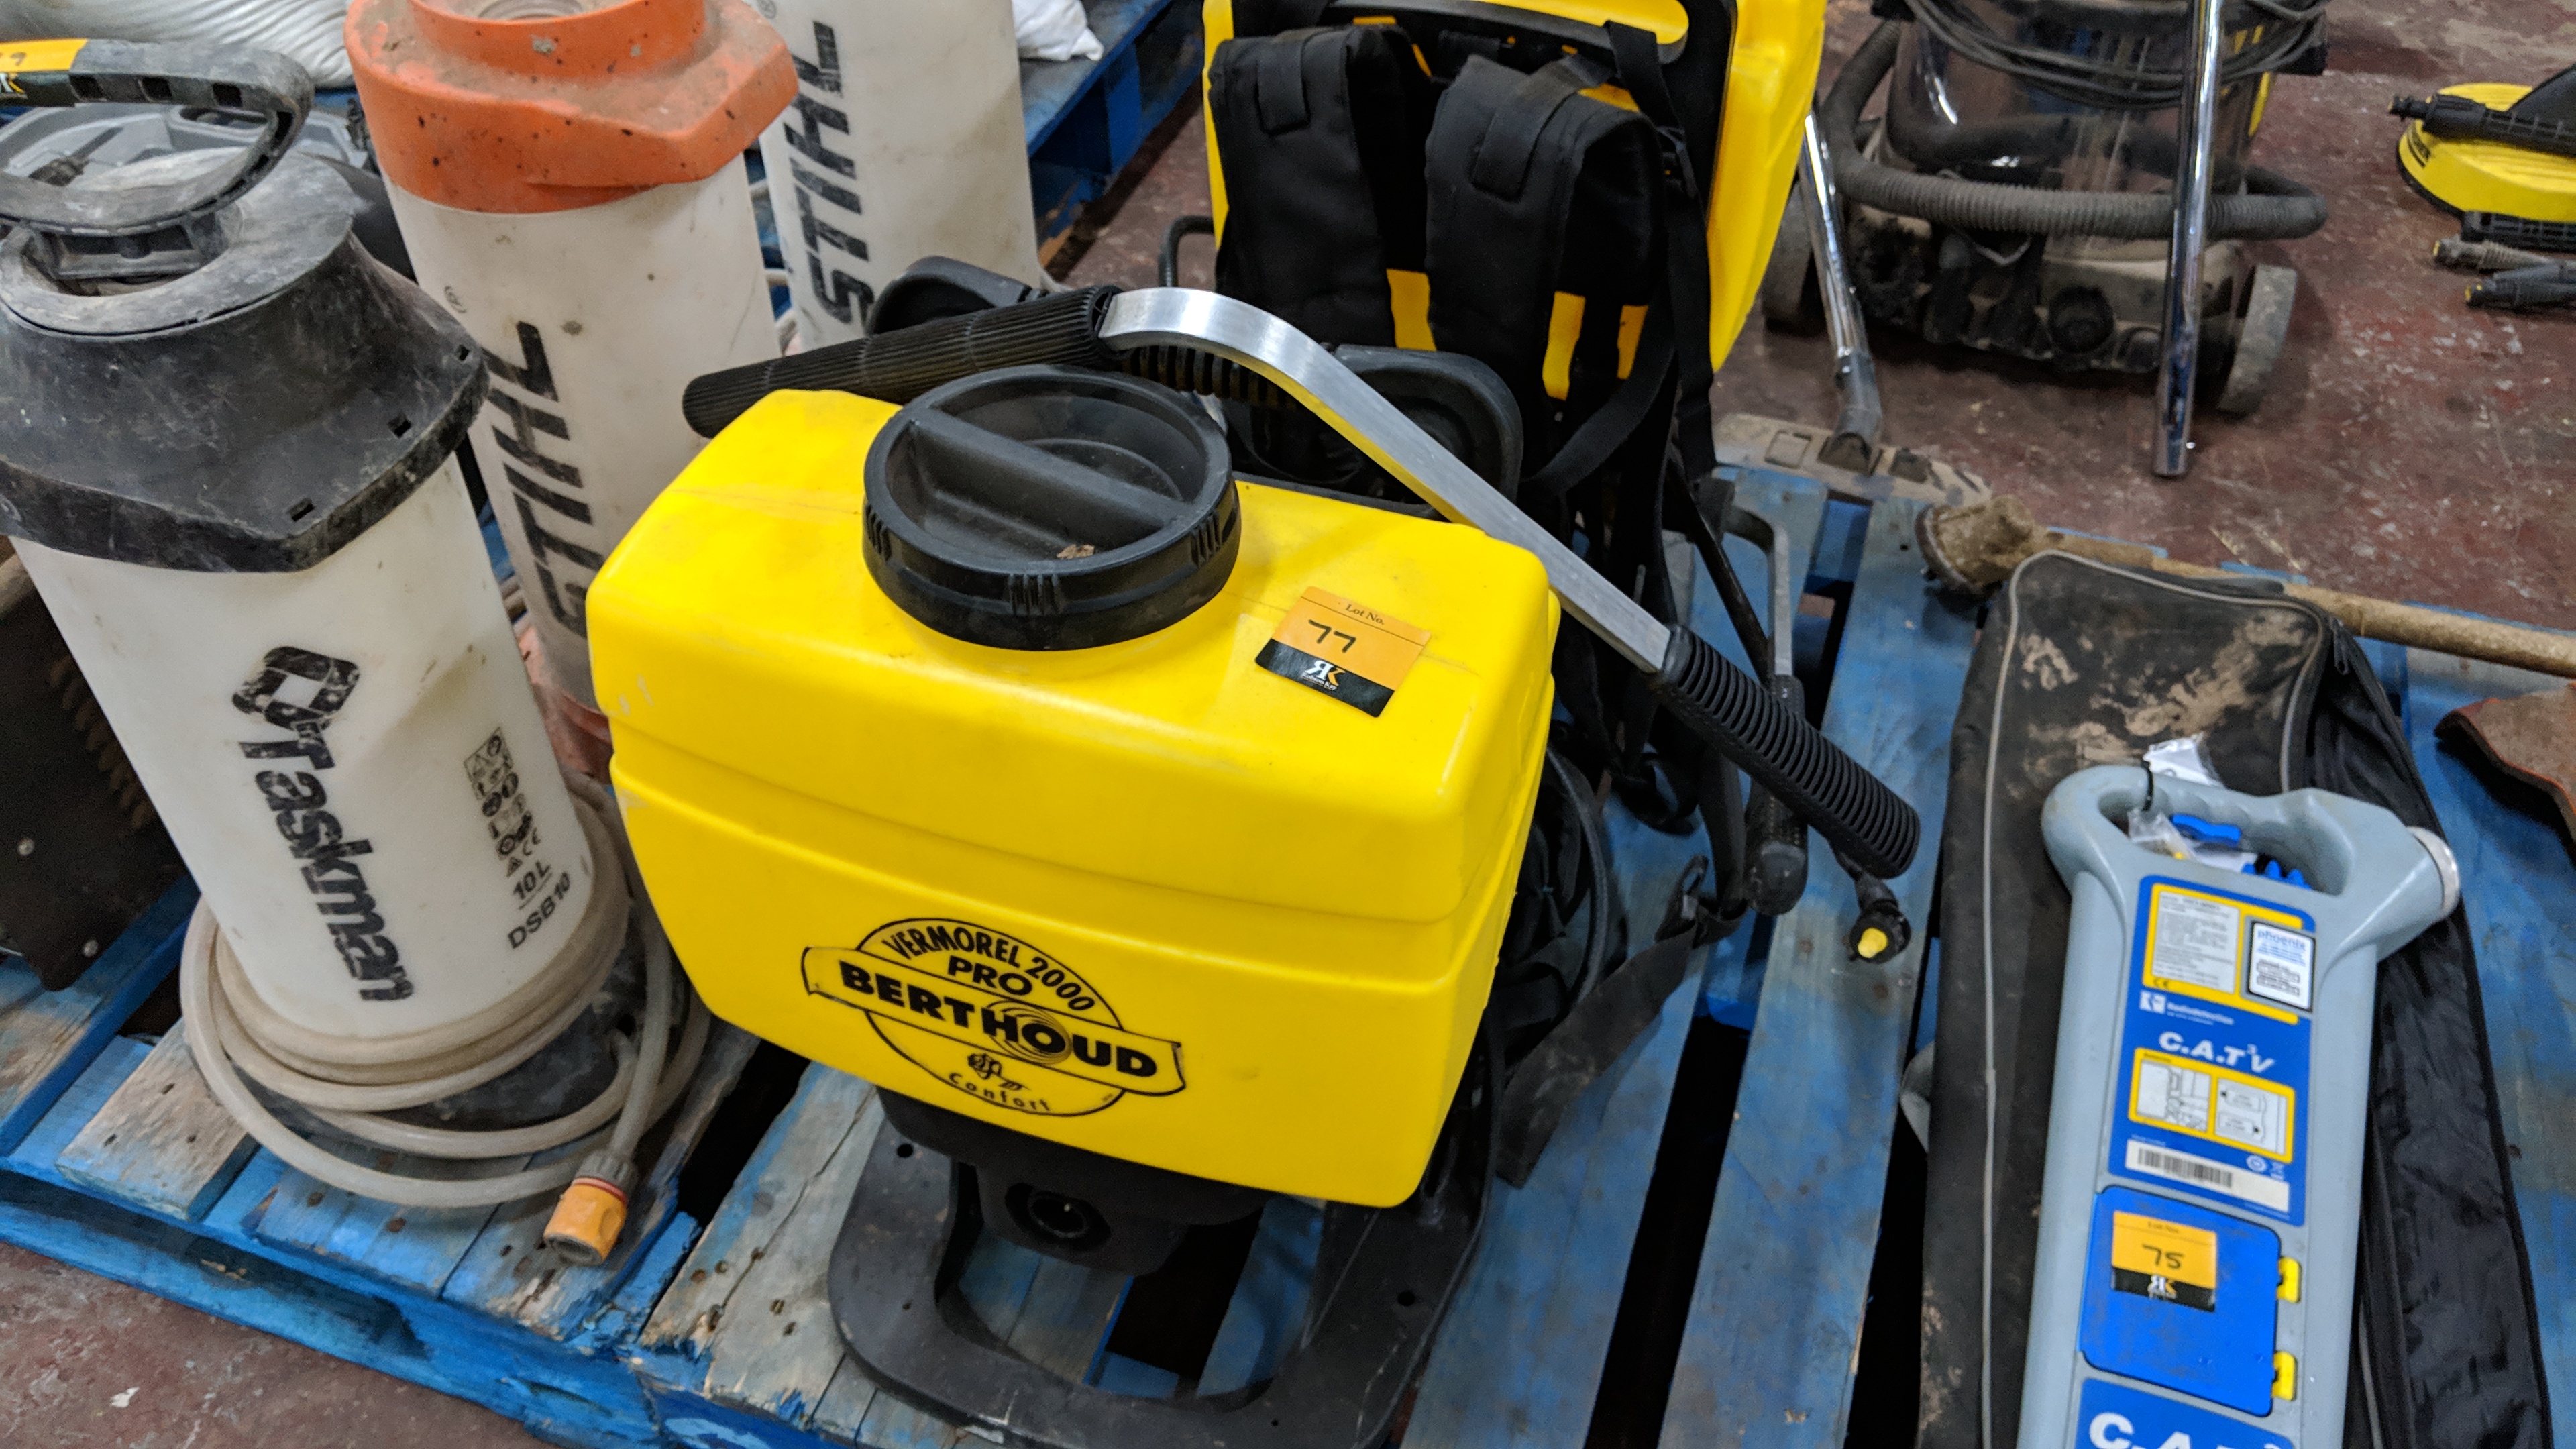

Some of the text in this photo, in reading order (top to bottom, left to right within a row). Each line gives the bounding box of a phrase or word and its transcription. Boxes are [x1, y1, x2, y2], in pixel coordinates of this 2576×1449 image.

[784, 21, 874, 335] STIHL
[1345, 604, 1385, 625] Lot No.
[1308, 619, 1356, 653] 77
[239, 719, 414, 1001] Taskman
[883, 926, 1095, 1011] VERMOREL 2000
[947, 955, 1032, 996] PRO
[839, 960, 1158, 1078] BERTHOUD
[949, 1072, 1051, 1112] Confort
[2141, 1243, 2184, 1269] 75
